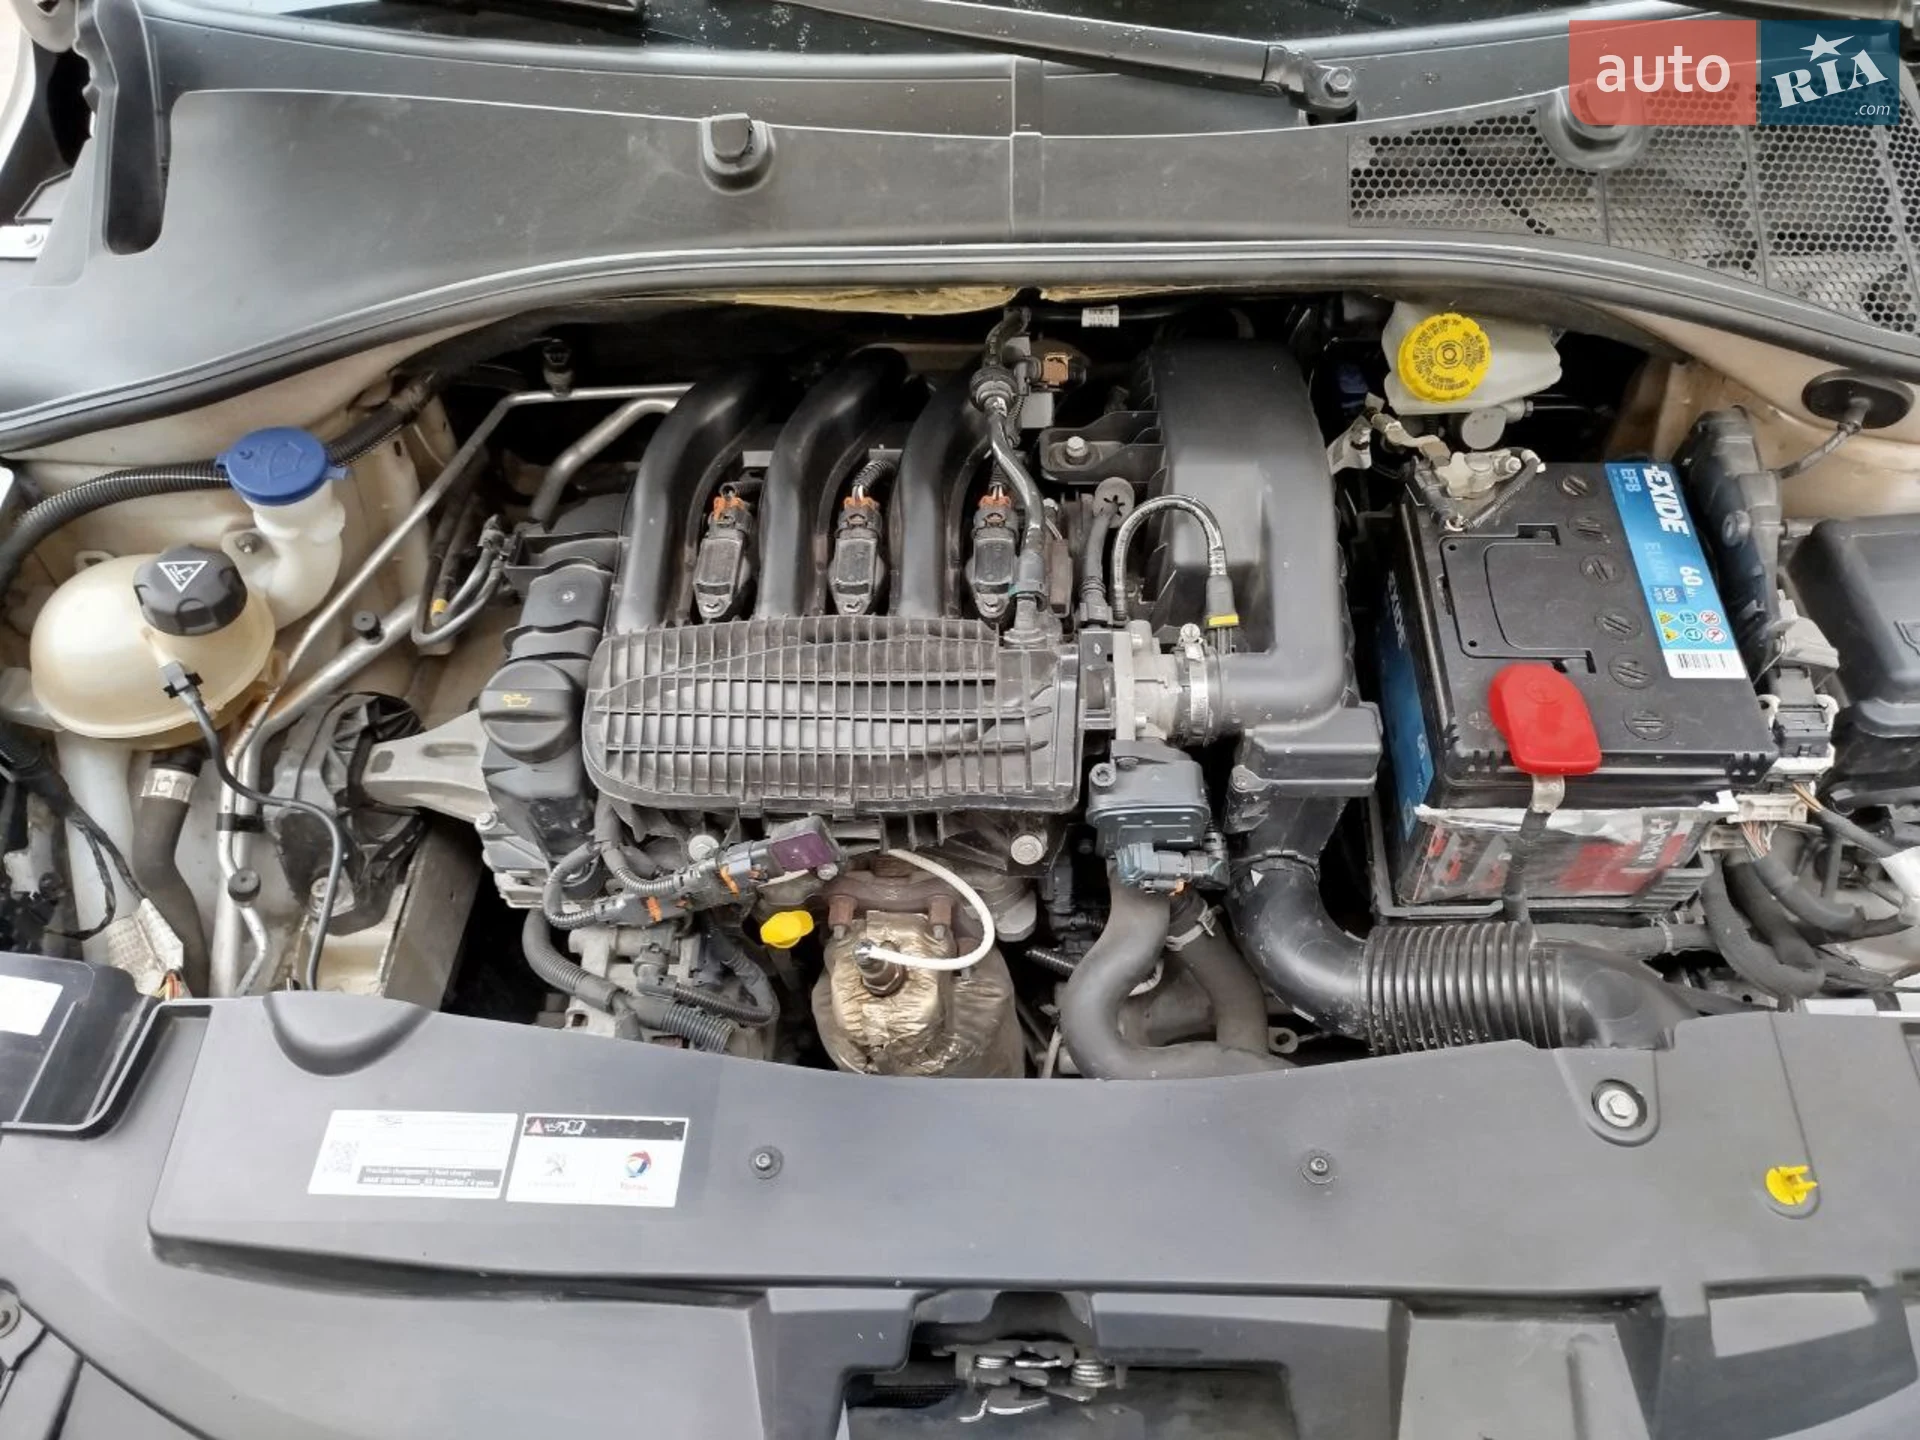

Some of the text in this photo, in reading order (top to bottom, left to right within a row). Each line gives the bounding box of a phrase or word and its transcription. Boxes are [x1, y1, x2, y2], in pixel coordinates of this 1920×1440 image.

[1619, 468, 1642, 493] EFB
[1642, 465, 1690, 536] EXIDE
[1680, 566, 1703, 586] 60
